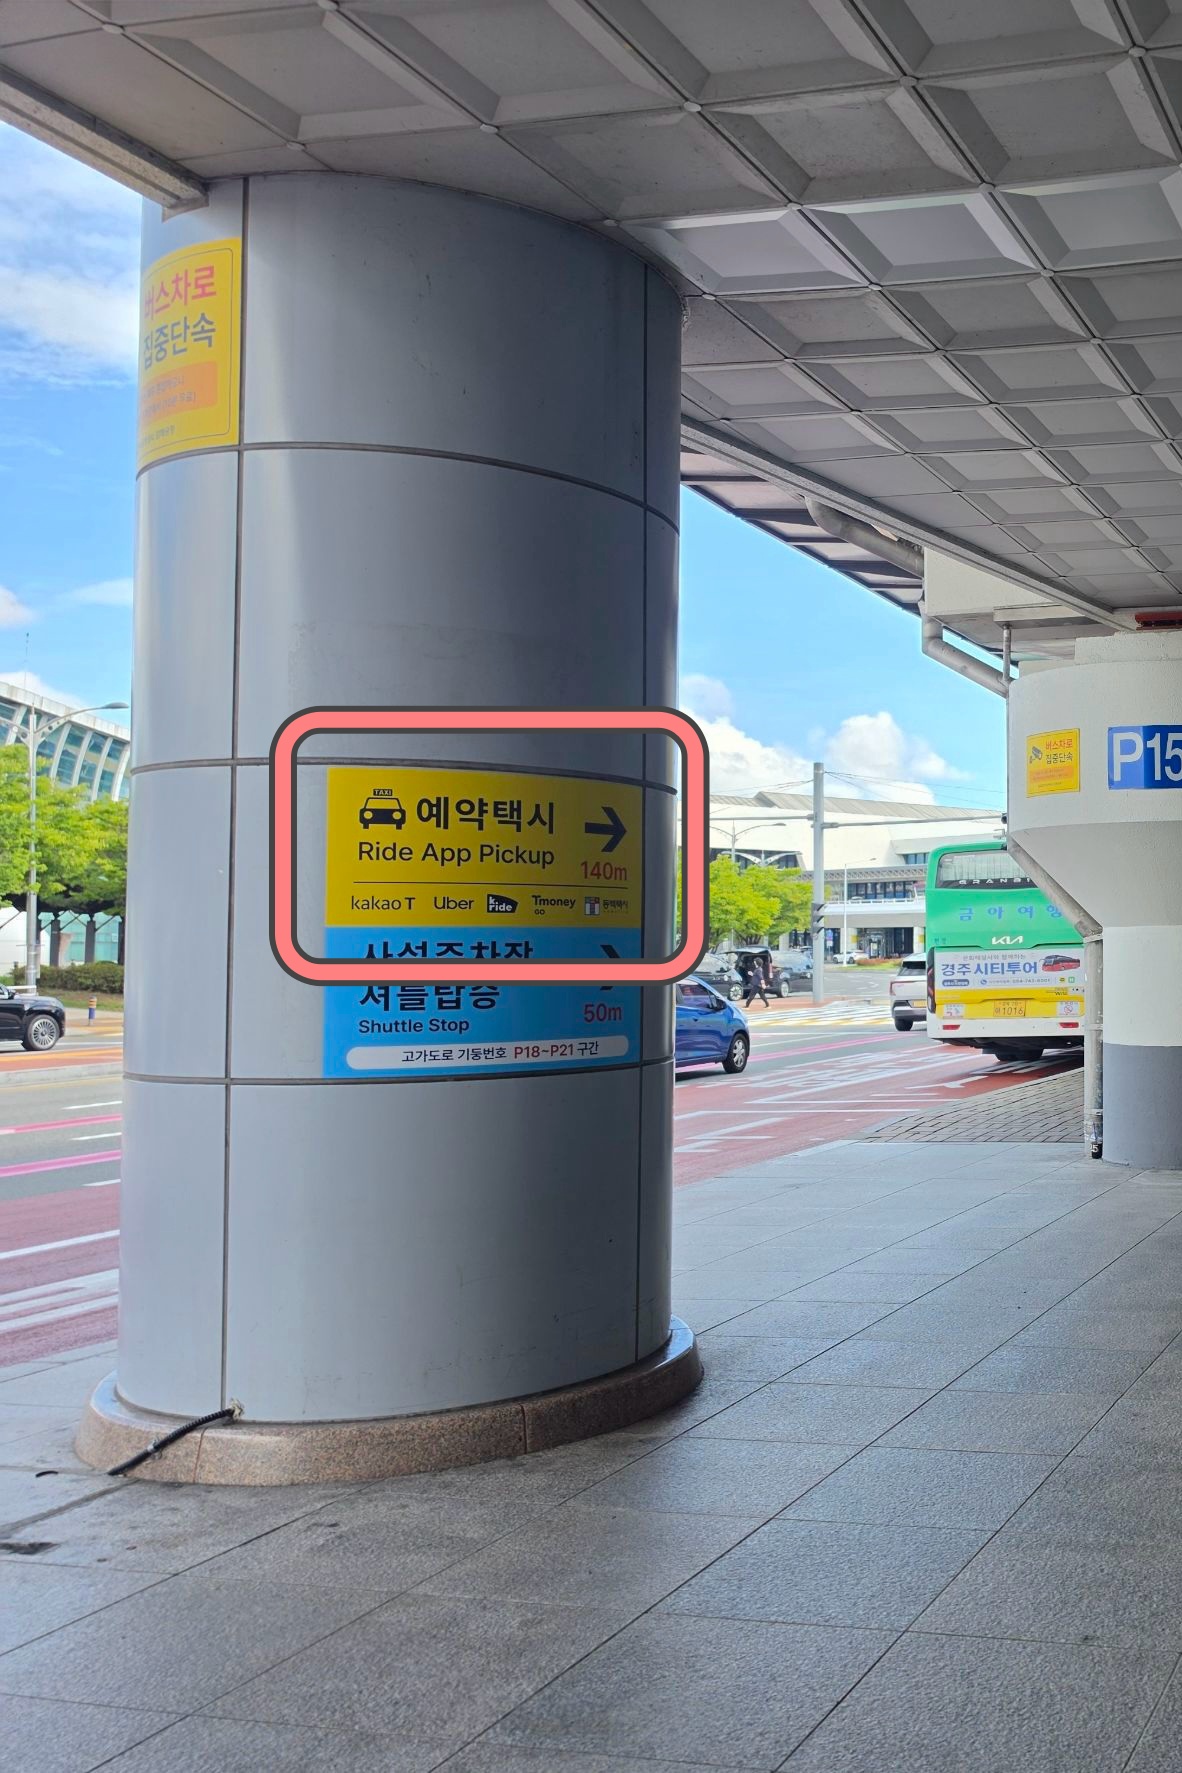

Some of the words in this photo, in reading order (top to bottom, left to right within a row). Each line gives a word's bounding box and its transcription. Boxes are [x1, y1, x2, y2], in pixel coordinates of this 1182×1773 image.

[416, 796, 555, 834] 예약택시
[358, 841, 413, 861] Ride
[421, 843, 471, 867] App
[479, 844, 555, 869] Pickup
[580, 860, 628, 881] 140m
[959, 877, 1031, 885] GRANBI
[351, 895, 401, 911] kakao
[404, 897, 416, 910] T
[434, 896, 475, 910] Uber
[532, 895, 576, 909] Tmoney
[941, 963, 971, 977] 경주
[974, 962, 1038, 976] 시티투어
[584, 1003, 622, 1022] 50m
[358, 1018, 423, 1034] Shuttle
[428, 1019, 470, 1034] Stop
[401, 1049, 454, 1063] 고가도로
[457, 1047, 507, 1061] 기둥번호
[513, 1043, 574, 1059] P18~P21
[577, 1042, 599, 1056] 구간
